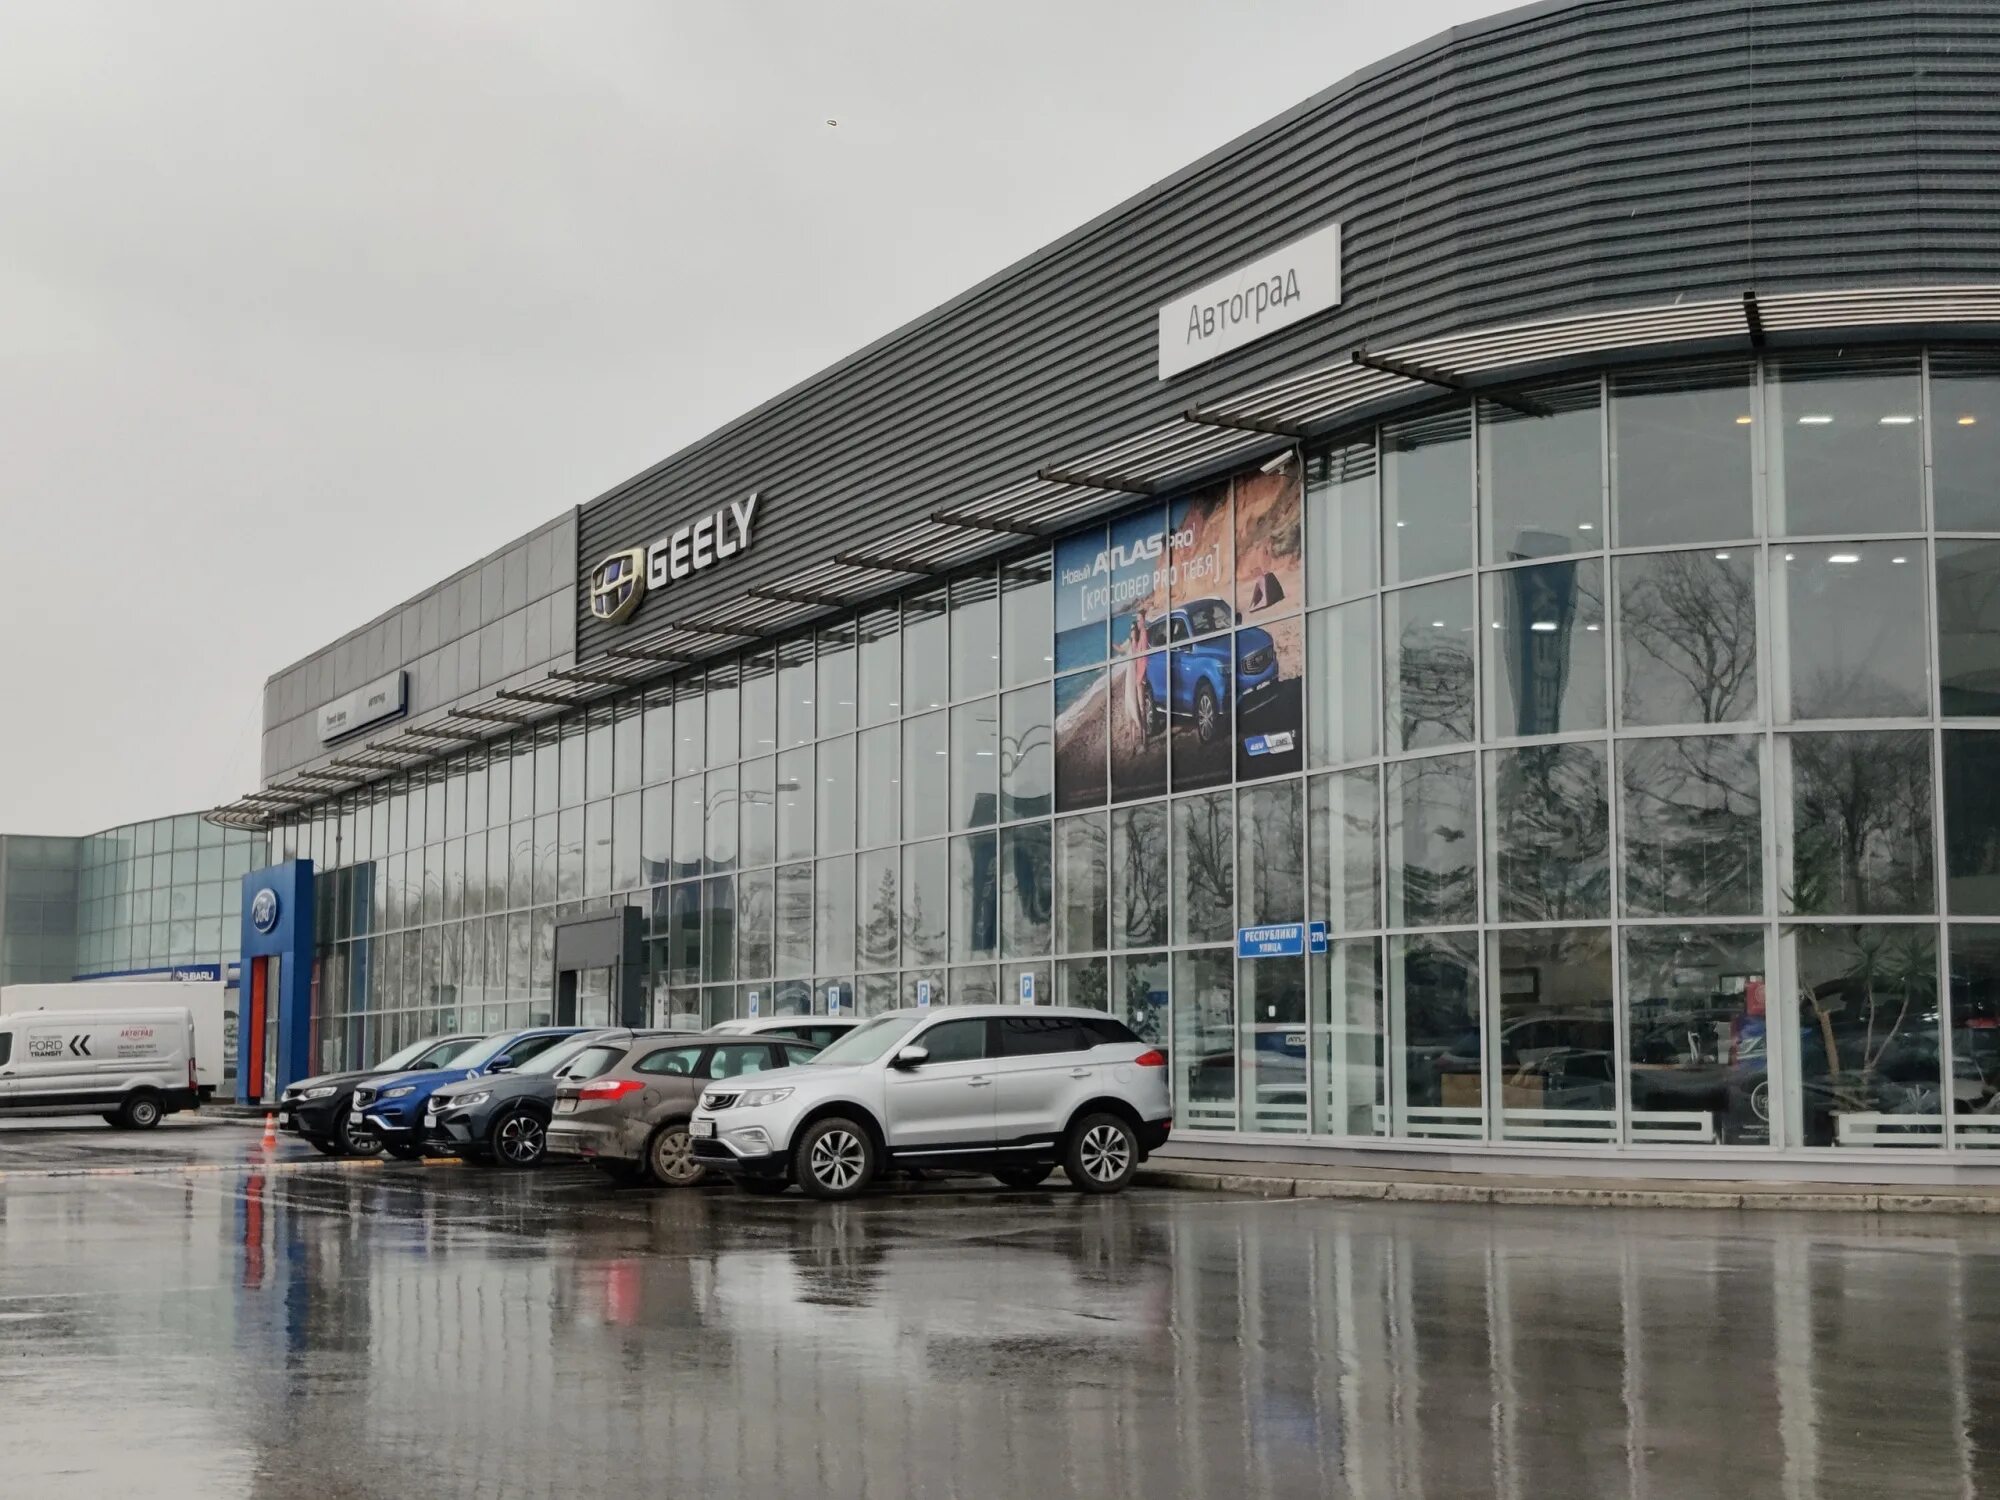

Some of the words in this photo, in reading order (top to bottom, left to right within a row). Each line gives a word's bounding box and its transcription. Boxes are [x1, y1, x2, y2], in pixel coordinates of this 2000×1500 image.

[1186, 268, 1301, 346] Автоград
[646, 492, 759, 591] GEELY
[1061, 563, 1091, 587] Новый
[1092, 531, 1164, 577] ATLAS
[1153, 565, 1178, 591] PRO
[1244, 927, 1298, 943] РЕСПУБЛИКИ
[1258, 942, 1283, 953] УЛИЦА
[182, 971, 215, 981] SUBARU
[29, 1040, 63, 1051] FORD
